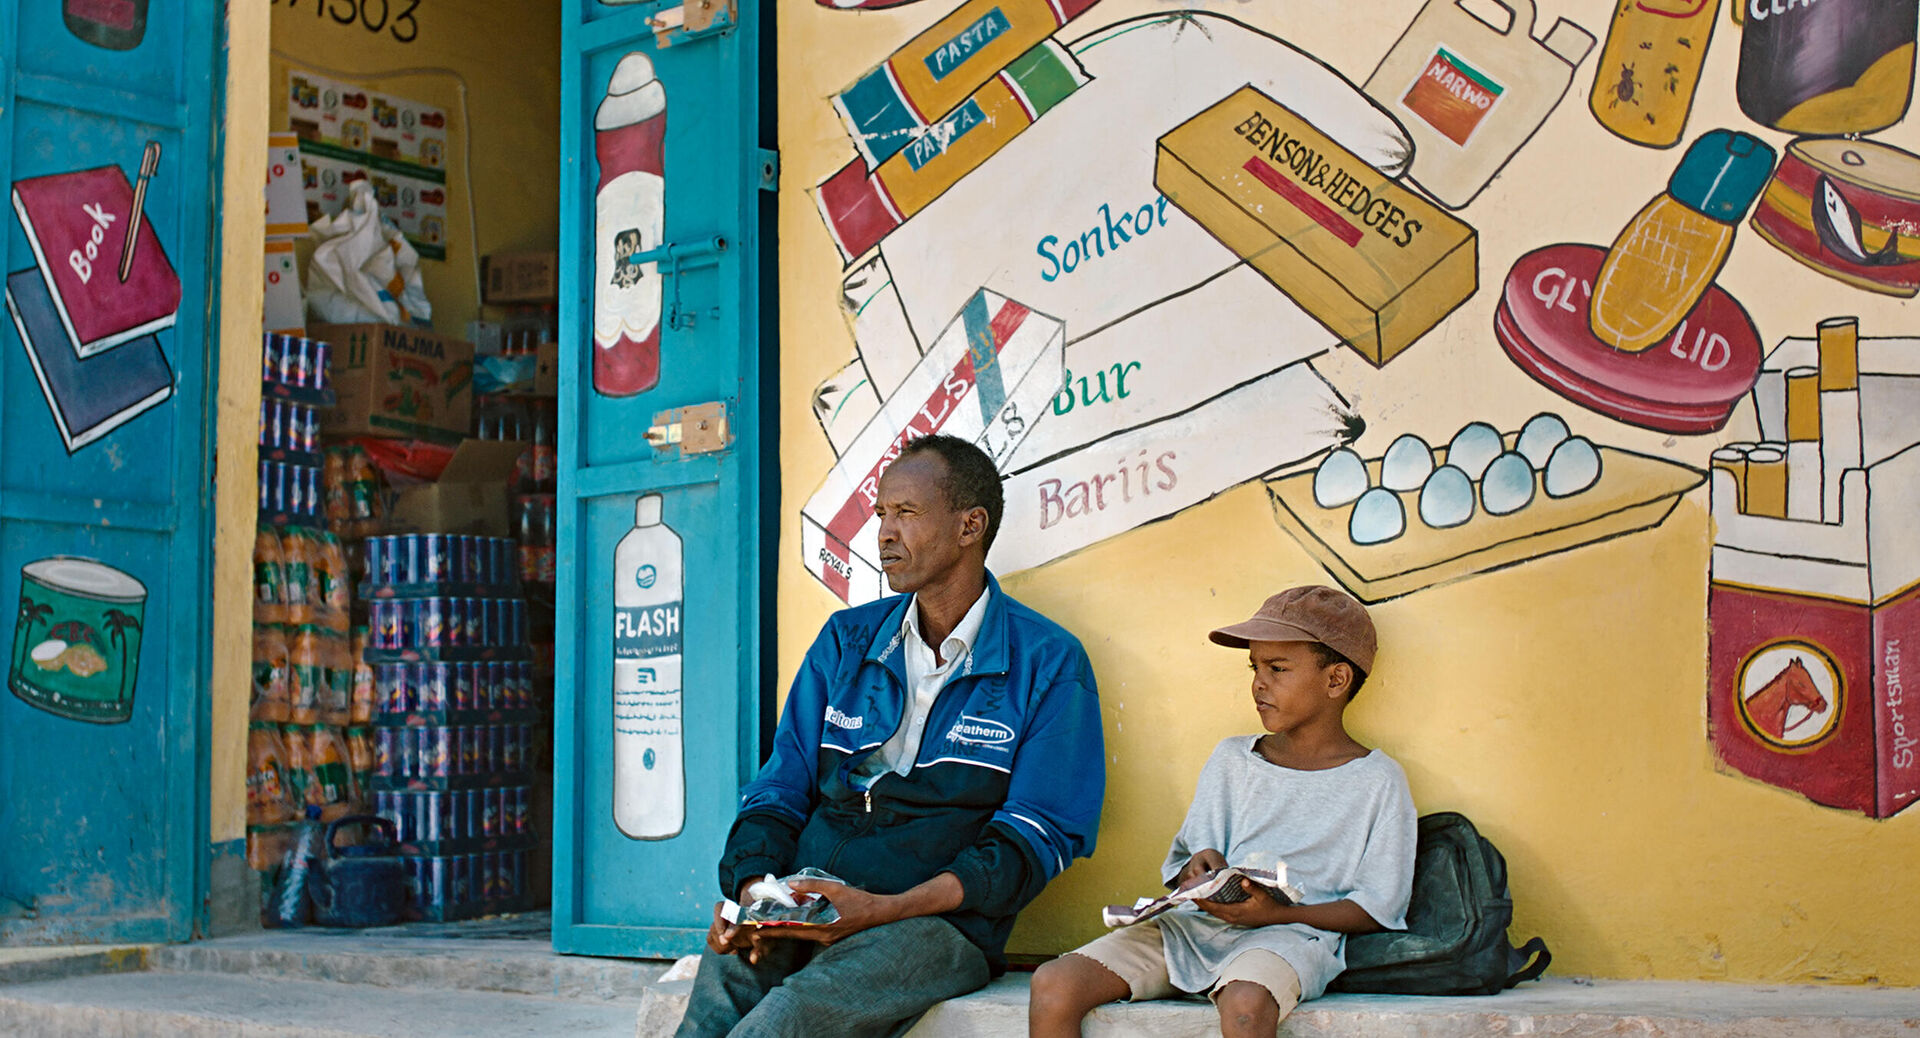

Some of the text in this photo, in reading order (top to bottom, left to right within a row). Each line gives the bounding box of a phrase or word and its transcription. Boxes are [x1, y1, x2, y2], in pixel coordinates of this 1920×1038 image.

[936, 17, 998, 71] PASTA
[915, 108, 974, 166] PATA
[1038, 449, 1177, 530] Bariis
[616, 607, 679, 638] FLASH
